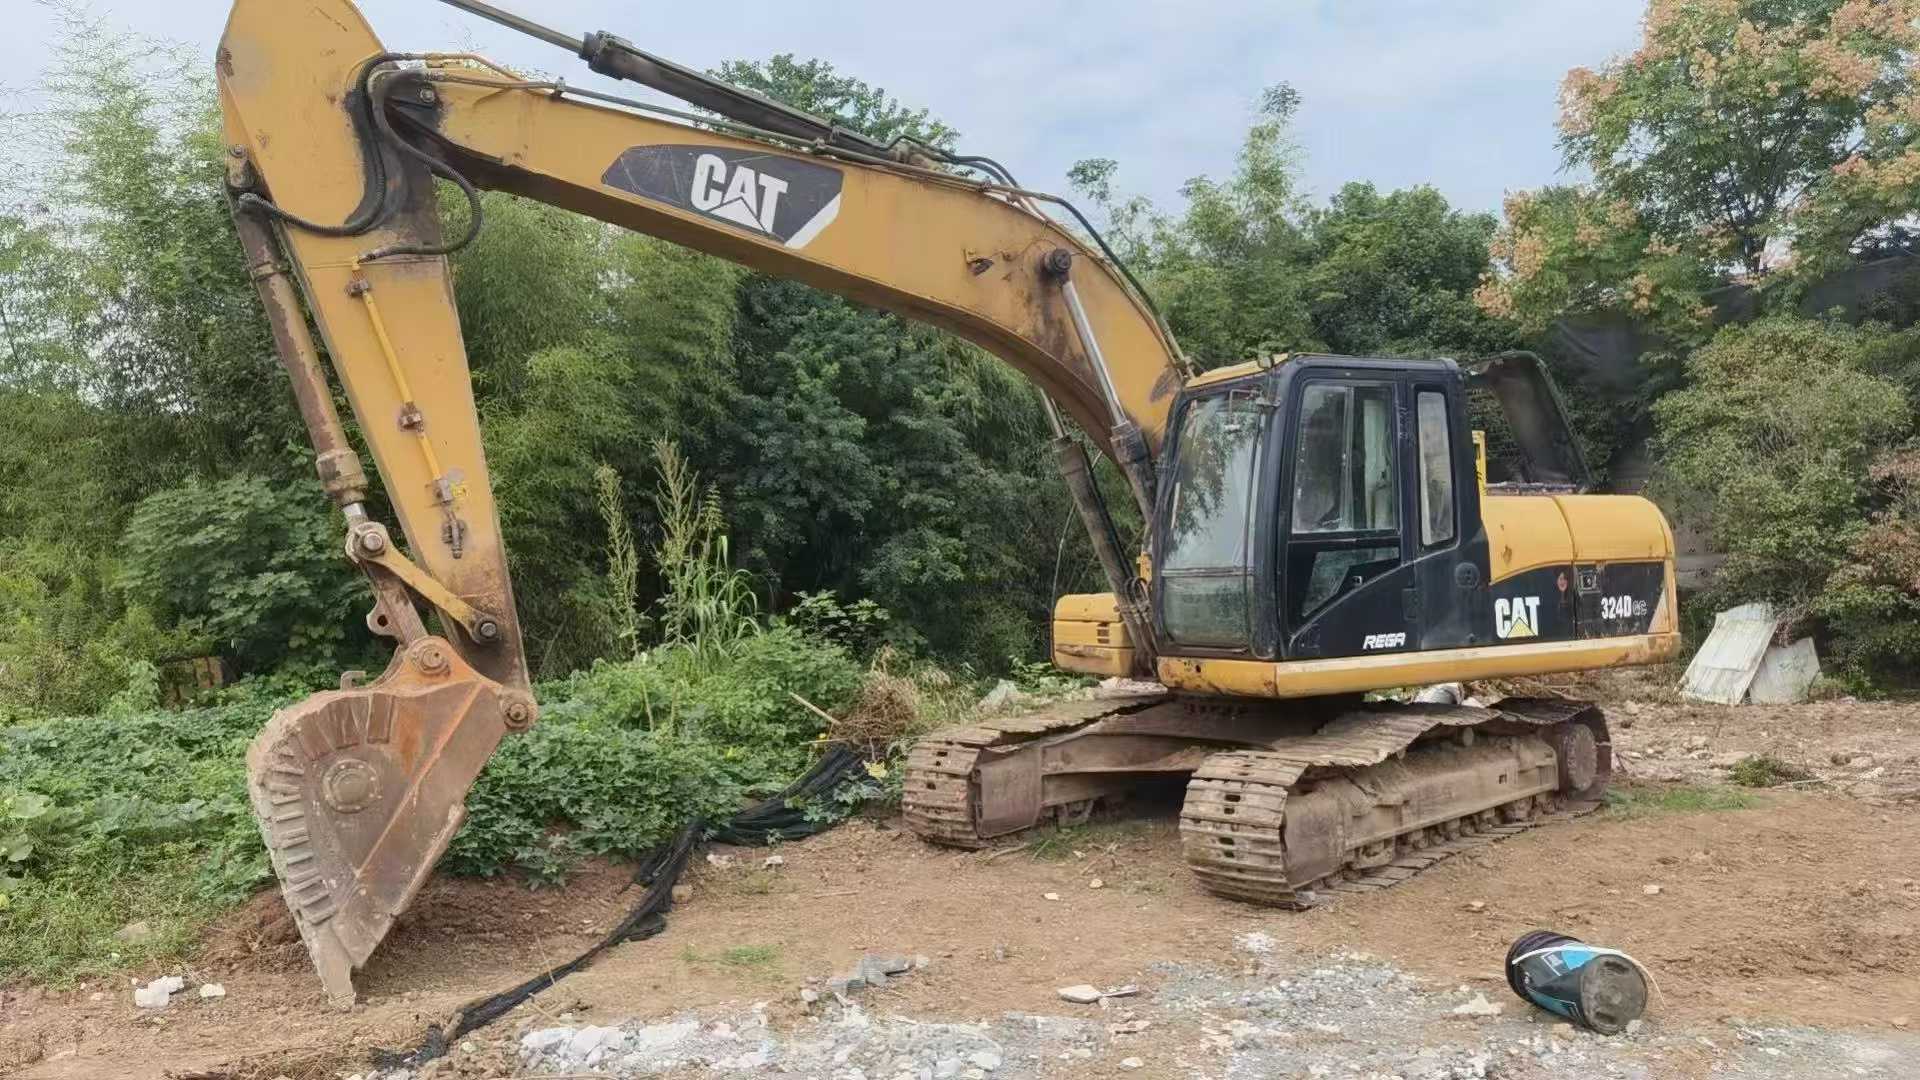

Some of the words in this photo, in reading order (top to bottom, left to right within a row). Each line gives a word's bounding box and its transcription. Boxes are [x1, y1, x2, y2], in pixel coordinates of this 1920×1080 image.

[690, 153, 788, 234] CAT
[1494, 596, 1540, 639] CAT
[1601, 594, 1632, 619] 324D
